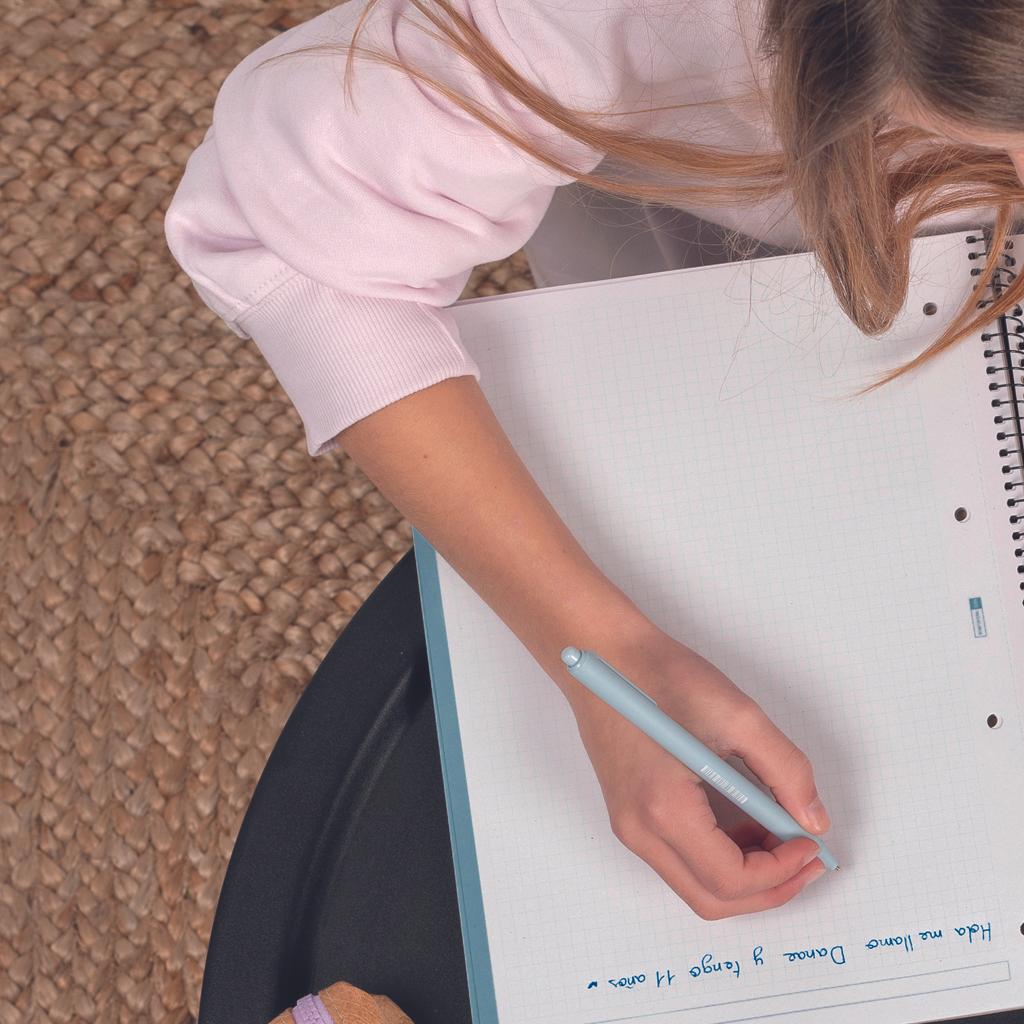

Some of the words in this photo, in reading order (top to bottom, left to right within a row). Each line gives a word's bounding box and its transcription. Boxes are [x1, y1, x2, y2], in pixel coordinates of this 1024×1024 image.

[864, 934, 914, 952] llamo
[918, 930, 944, 940] me
[954, 923, 992, 945] Hola
[752, 946, 763, 963] y
[783, 945, 846, 965] Danae
[689, 957, 741, 977] tengo
[608, 973, 646, 988] años
[655, 970, 677, 988] 11
